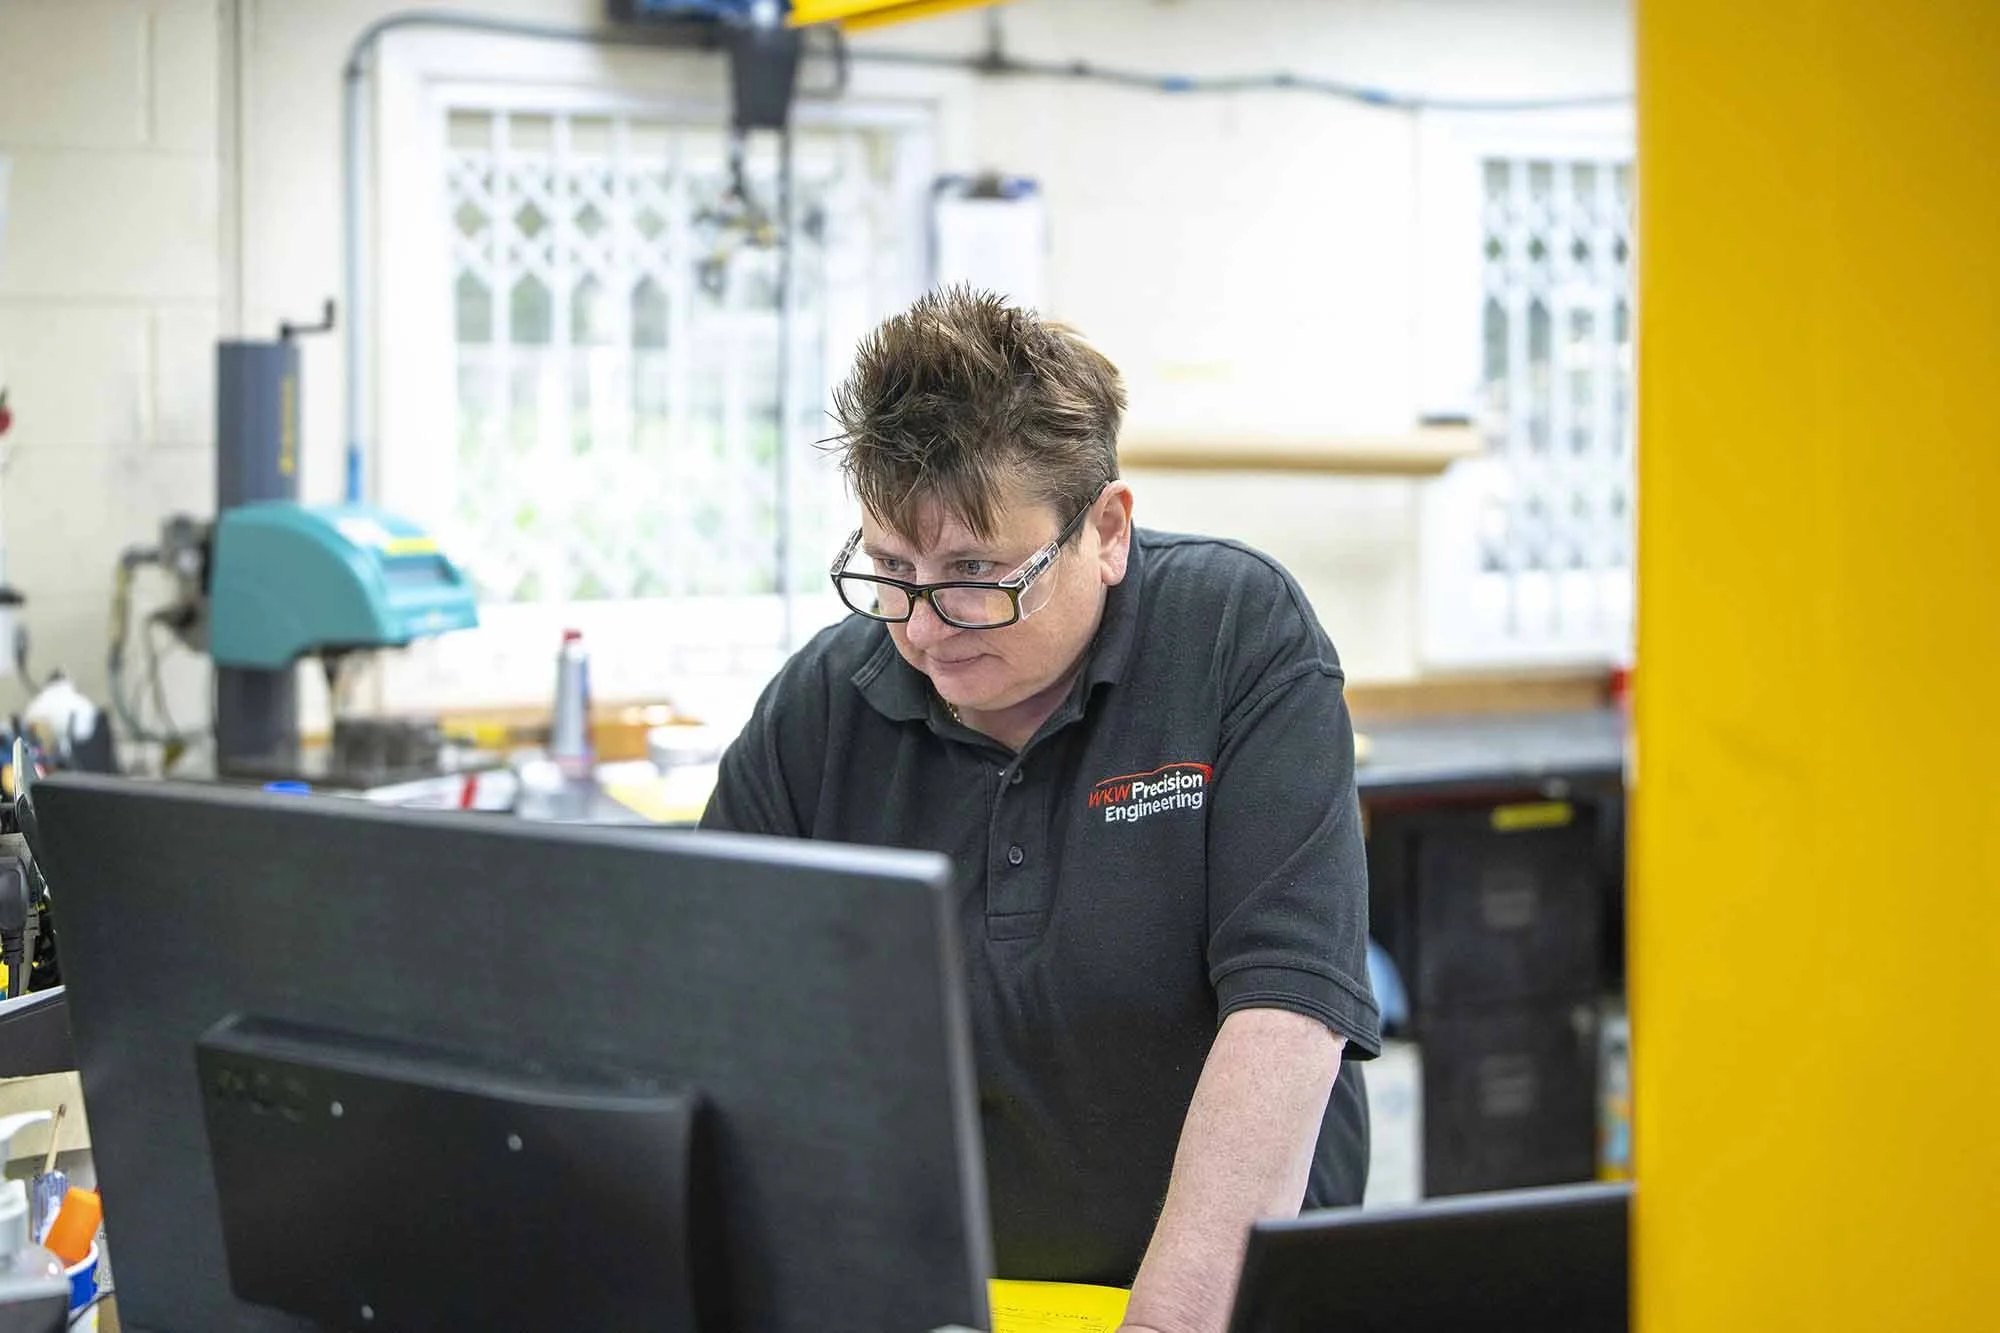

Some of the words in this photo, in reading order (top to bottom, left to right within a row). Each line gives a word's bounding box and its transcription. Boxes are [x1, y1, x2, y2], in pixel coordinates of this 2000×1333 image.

[1088, 783, 1131, 808] WKW
[1132, 770, 1203, 800] Precision
[1105, 790, 1203, 822] Engineering
